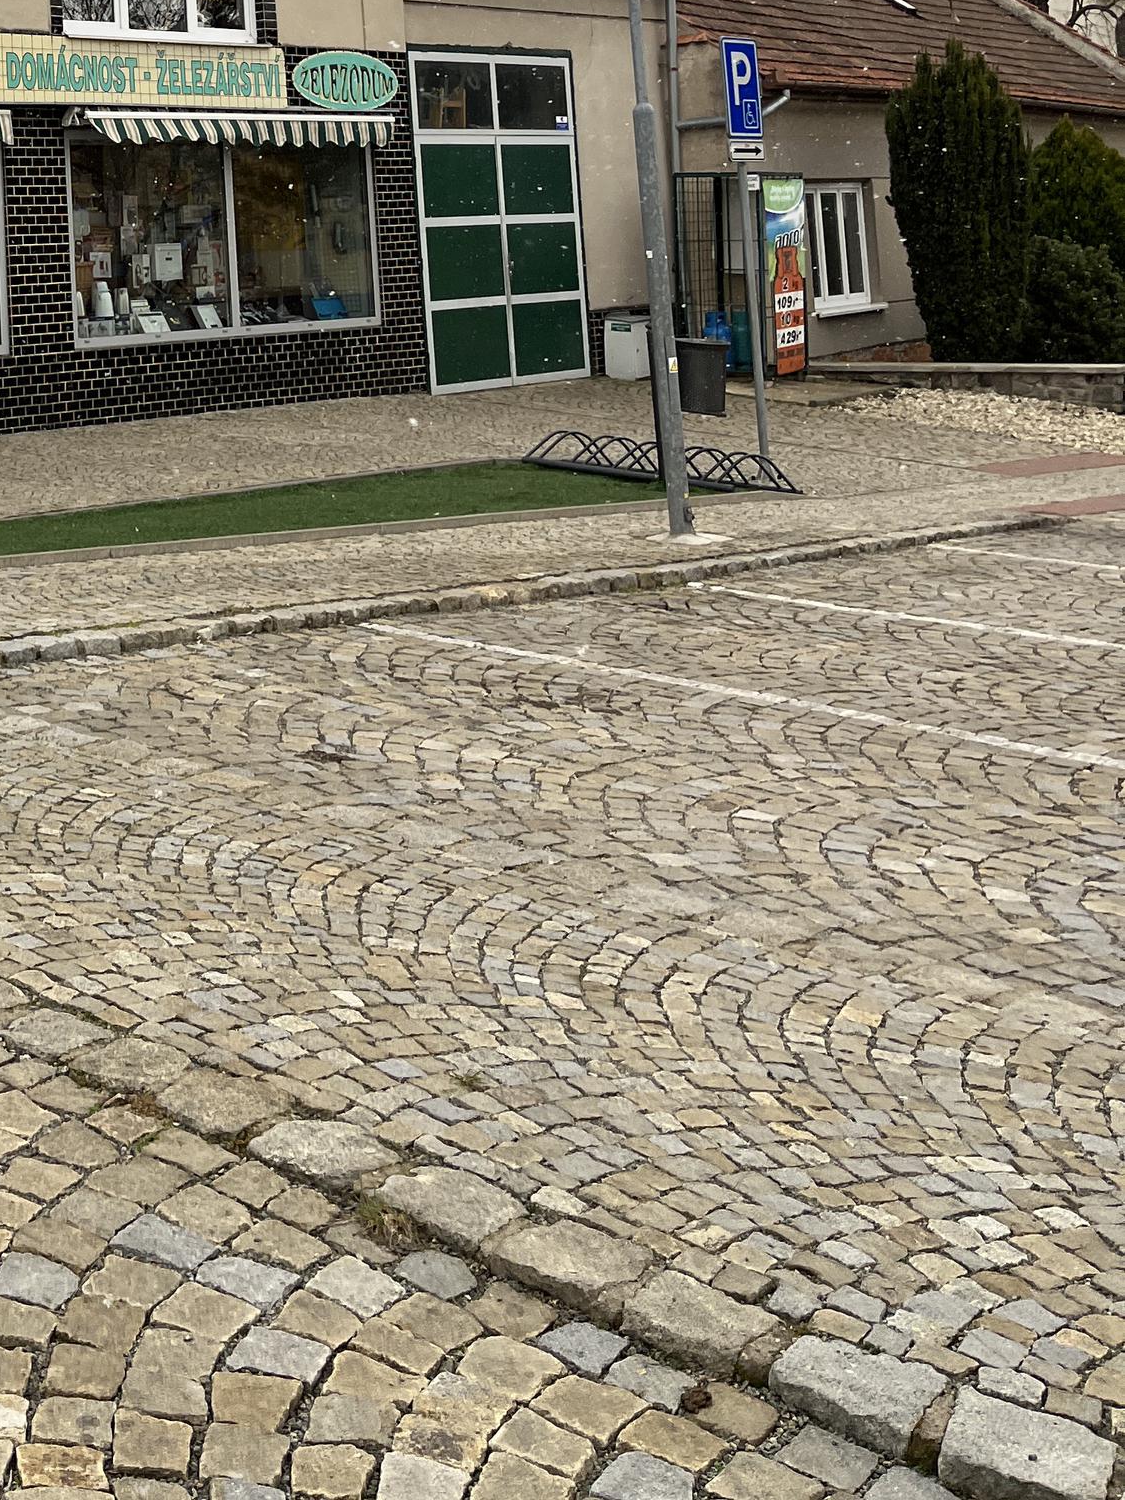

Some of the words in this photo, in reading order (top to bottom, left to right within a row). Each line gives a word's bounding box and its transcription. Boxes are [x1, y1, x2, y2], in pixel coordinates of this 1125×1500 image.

[6, 45, 138, 93] DOMÁCNOST
[155, 50, 281, 97] ŽELEZÁŘSTVÍ
[730, 51, 752, 106] P
[782, 277, 789, 291] 2
[780, 312, 792, 327] 10
